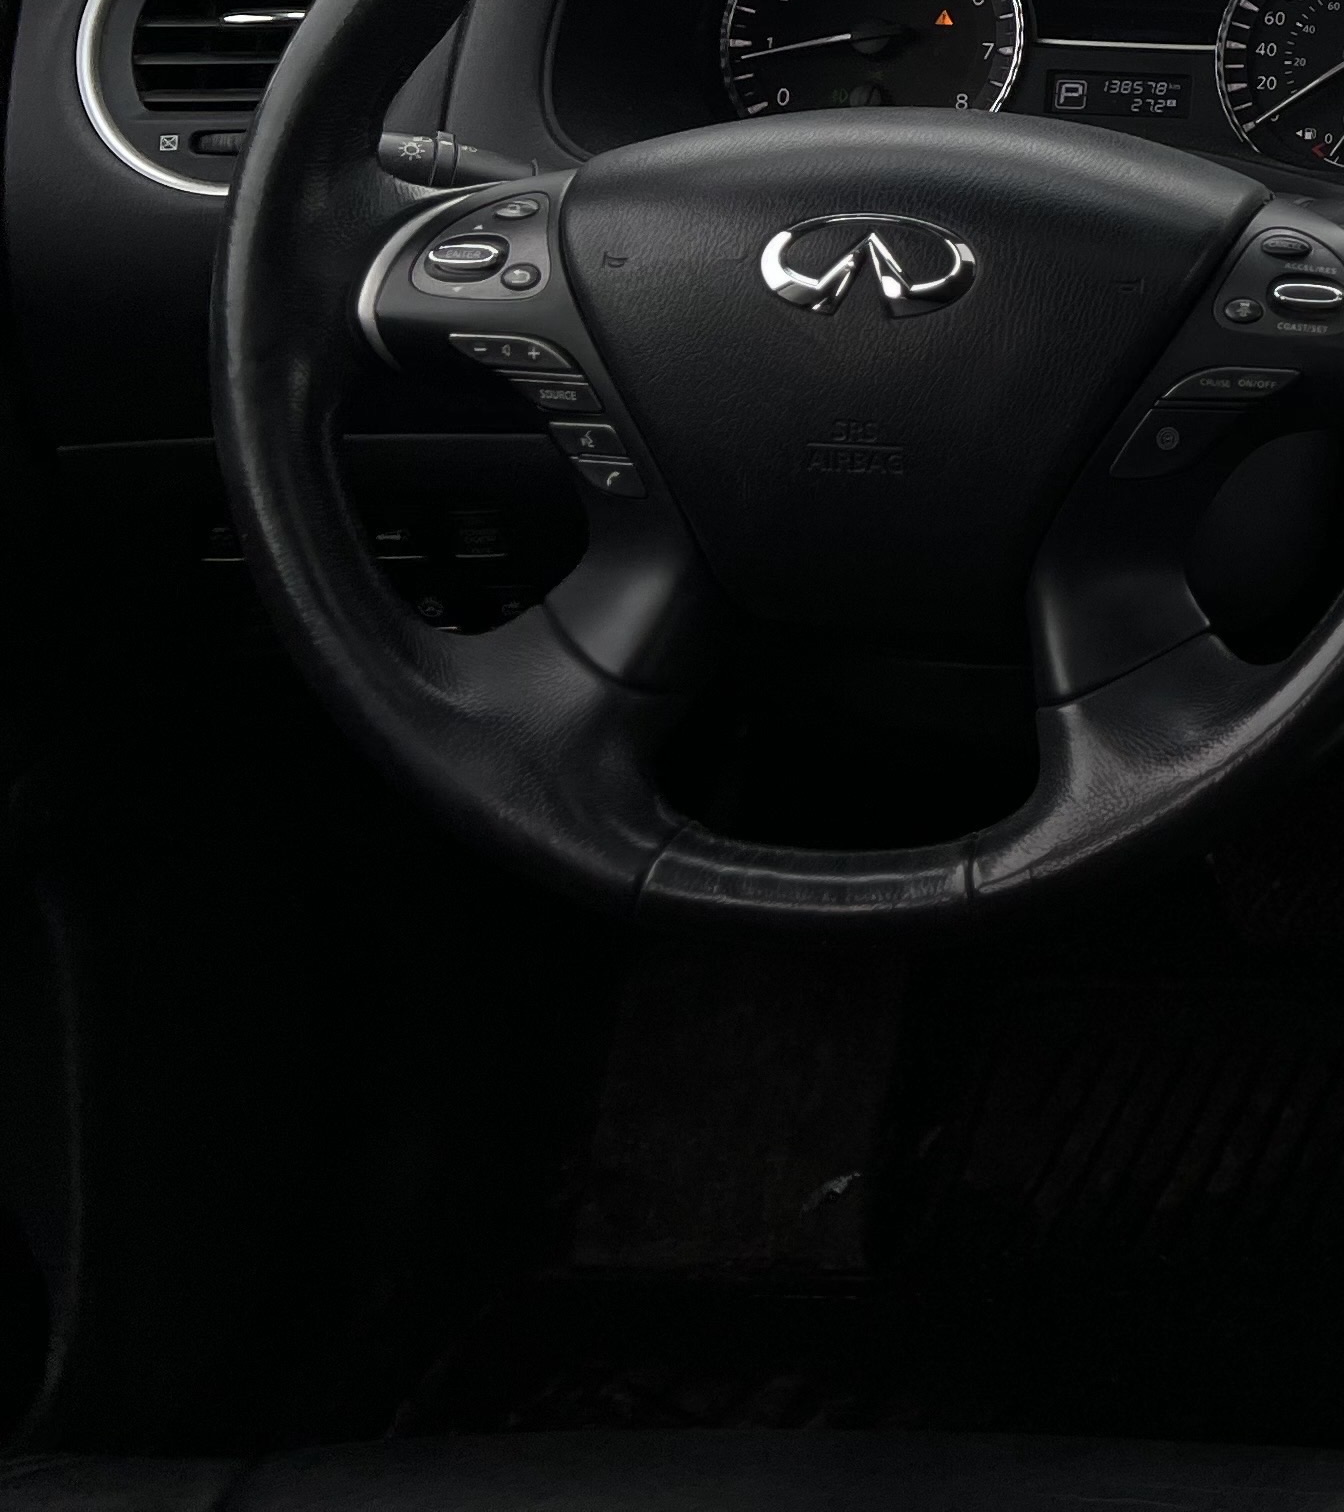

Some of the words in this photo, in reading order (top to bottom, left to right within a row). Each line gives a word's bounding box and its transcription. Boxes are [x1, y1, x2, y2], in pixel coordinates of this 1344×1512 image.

[1327, 1, 1341, 11] 60
[1263, 11, 1286, 26] 60
[1302, 24, 1316, 35] 40
[983, 42, 995, 60] 7
[1255, 42, 1277, 57] 40
[1293, 57, 1307, 67] 20
[1103, 79, 1168, 96] 138578
[1256, 75, 1277, 90] 20
[777, 87, 790, 106] 0
[1059, 82, 1083, 105] P
[955, 93, 969, 110] 8
[1324, 132, 1333, 144] 0
[445, 248, 483, 260] ENTER
[1283, 261, 1337, 276] ACCEL/RES
[1276, 321, 1329, 334] COAST/SET
[1199, 377, 1232, 388] CRUISE
[1237, 378, 1278, 390] ON/OFF
[539, 388, 578, 402] SOURCE
[831, 417, 878, 444] SRS
